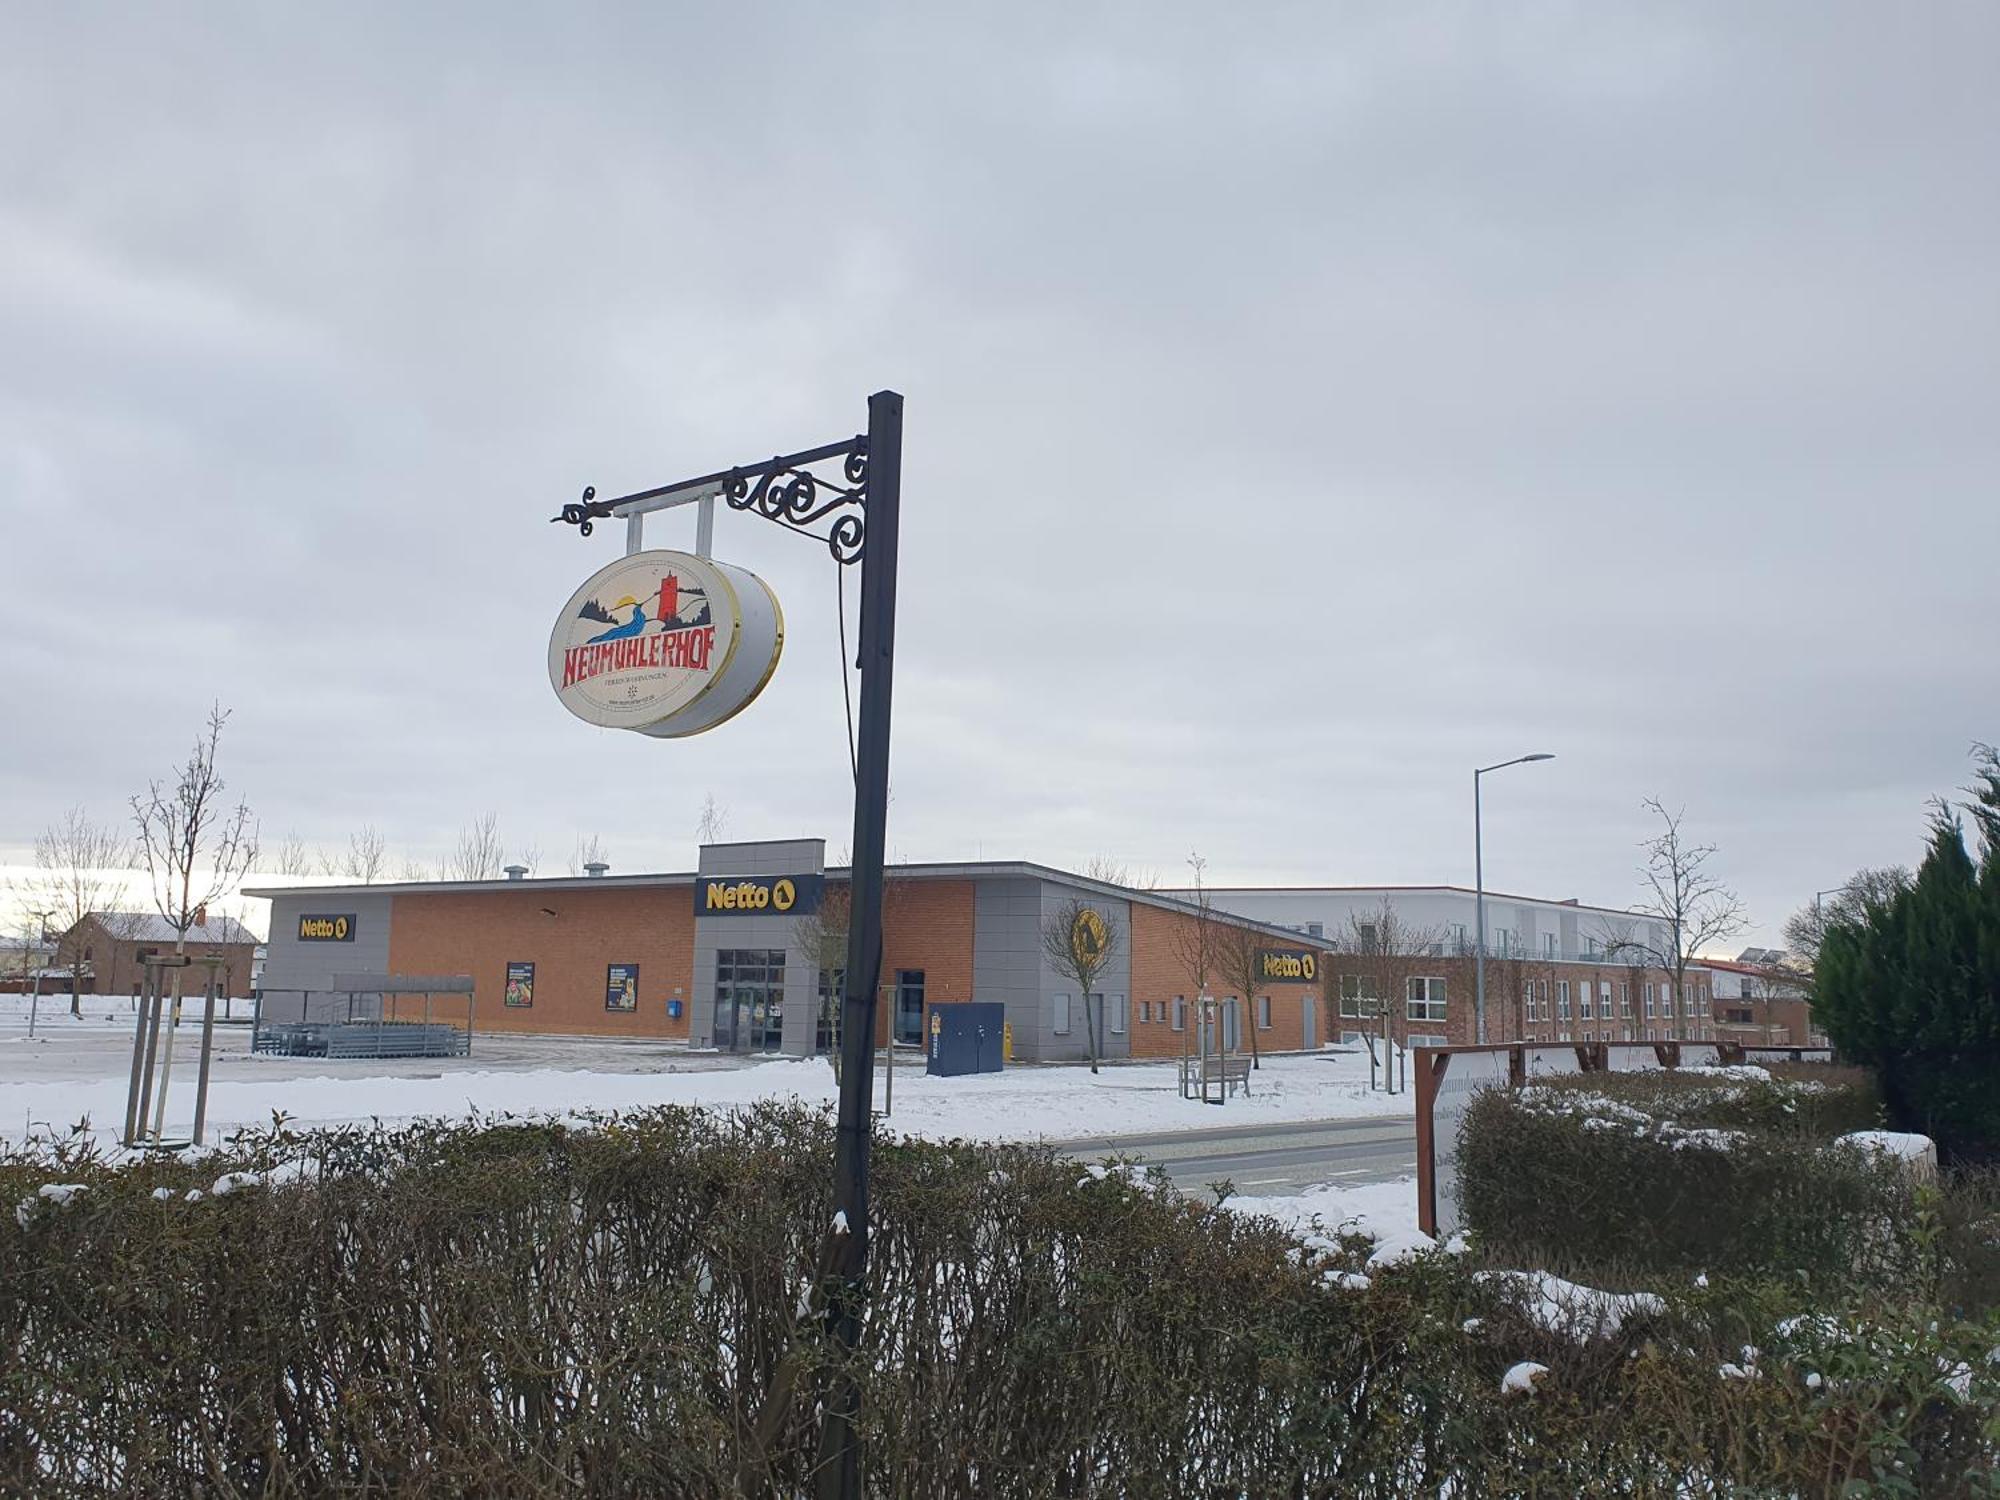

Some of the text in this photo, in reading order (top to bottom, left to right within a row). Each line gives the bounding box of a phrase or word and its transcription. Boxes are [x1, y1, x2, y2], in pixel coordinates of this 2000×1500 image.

[706, 882, 768, 908] Netto
[301, 919, 333, 936] Netto
[1263, 953, 1301, 976] Netto
